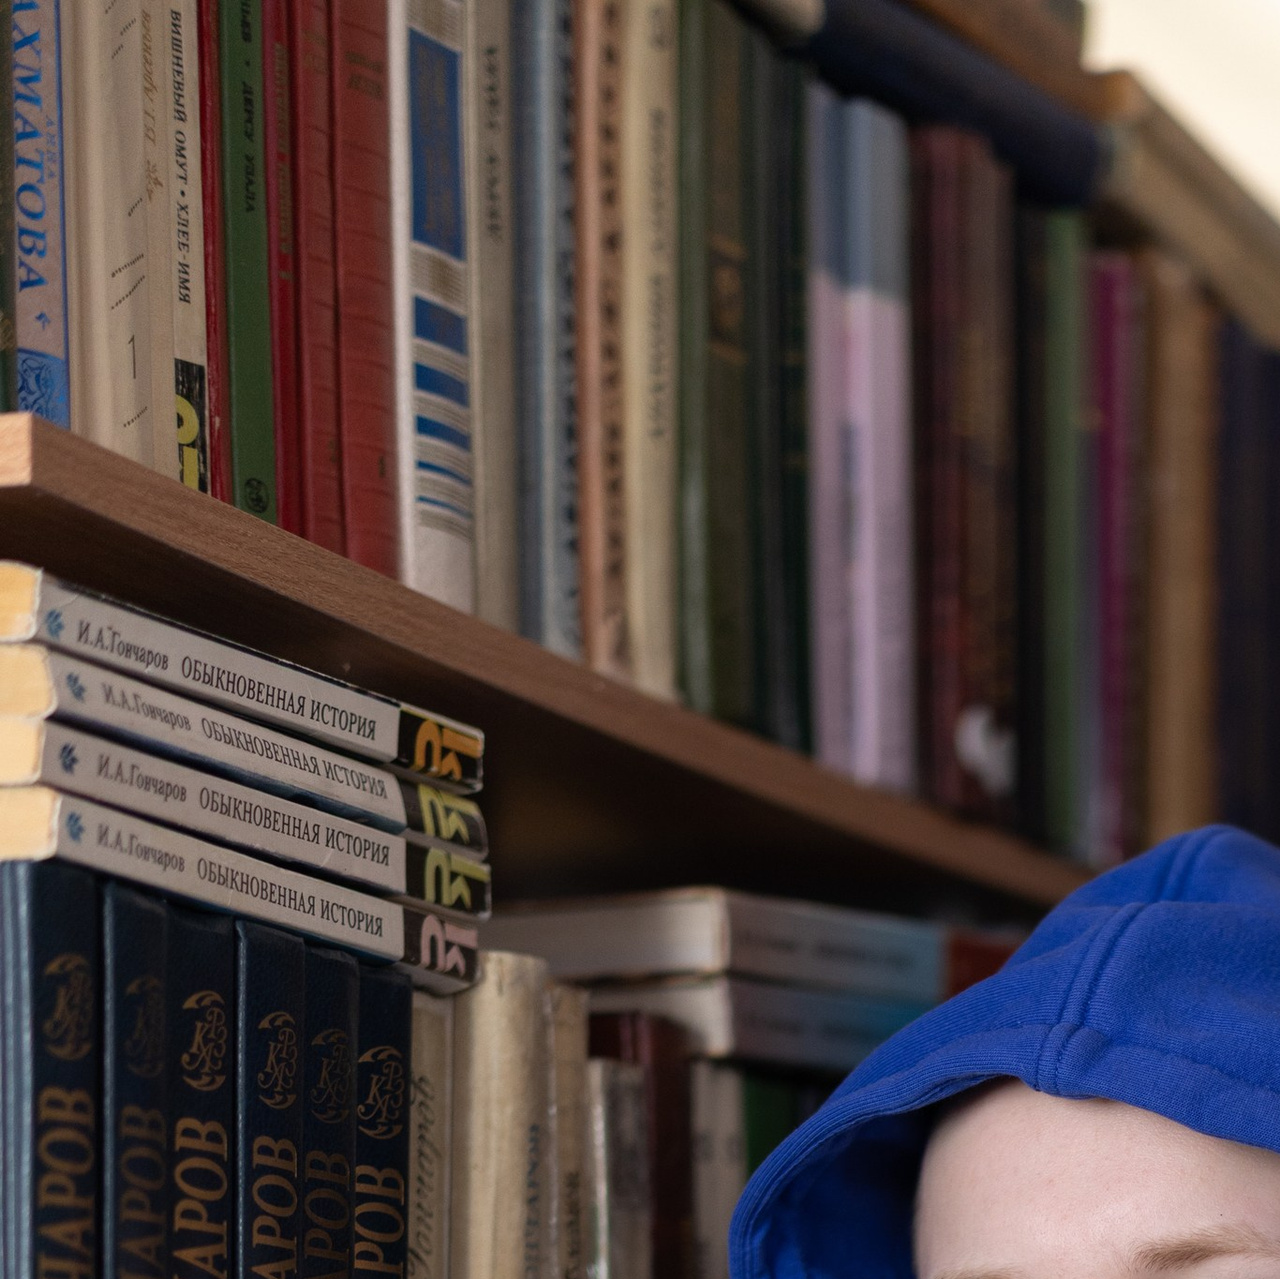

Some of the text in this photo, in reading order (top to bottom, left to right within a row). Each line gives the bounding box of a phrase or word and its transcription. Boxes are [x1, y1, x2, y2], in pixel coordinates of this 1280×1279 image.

[170, 9, 188, 124] ВИШНЕВЫЙ
[175, 130, 189, 185] ОМУТ
[181, 655, 306, 719] ОБЫКНОВЕННАЯ
[310, 691, 378, 743] ИСТОРИЯ
[201, 716, 322, 778] ОБЫКНОВЕННАЯ
[324, 757, 389, 801] ИСТОРИЯ
[199, 786, 322, 846] ОБЫКНОВЕННАЯ
[324, 823, 391, 868] ИСТОРИЯ
[197, 857, 317, 918] ОБЫКНОВЕННАЯ
[319, 894, 384, 940] ИСТОРИЯ
